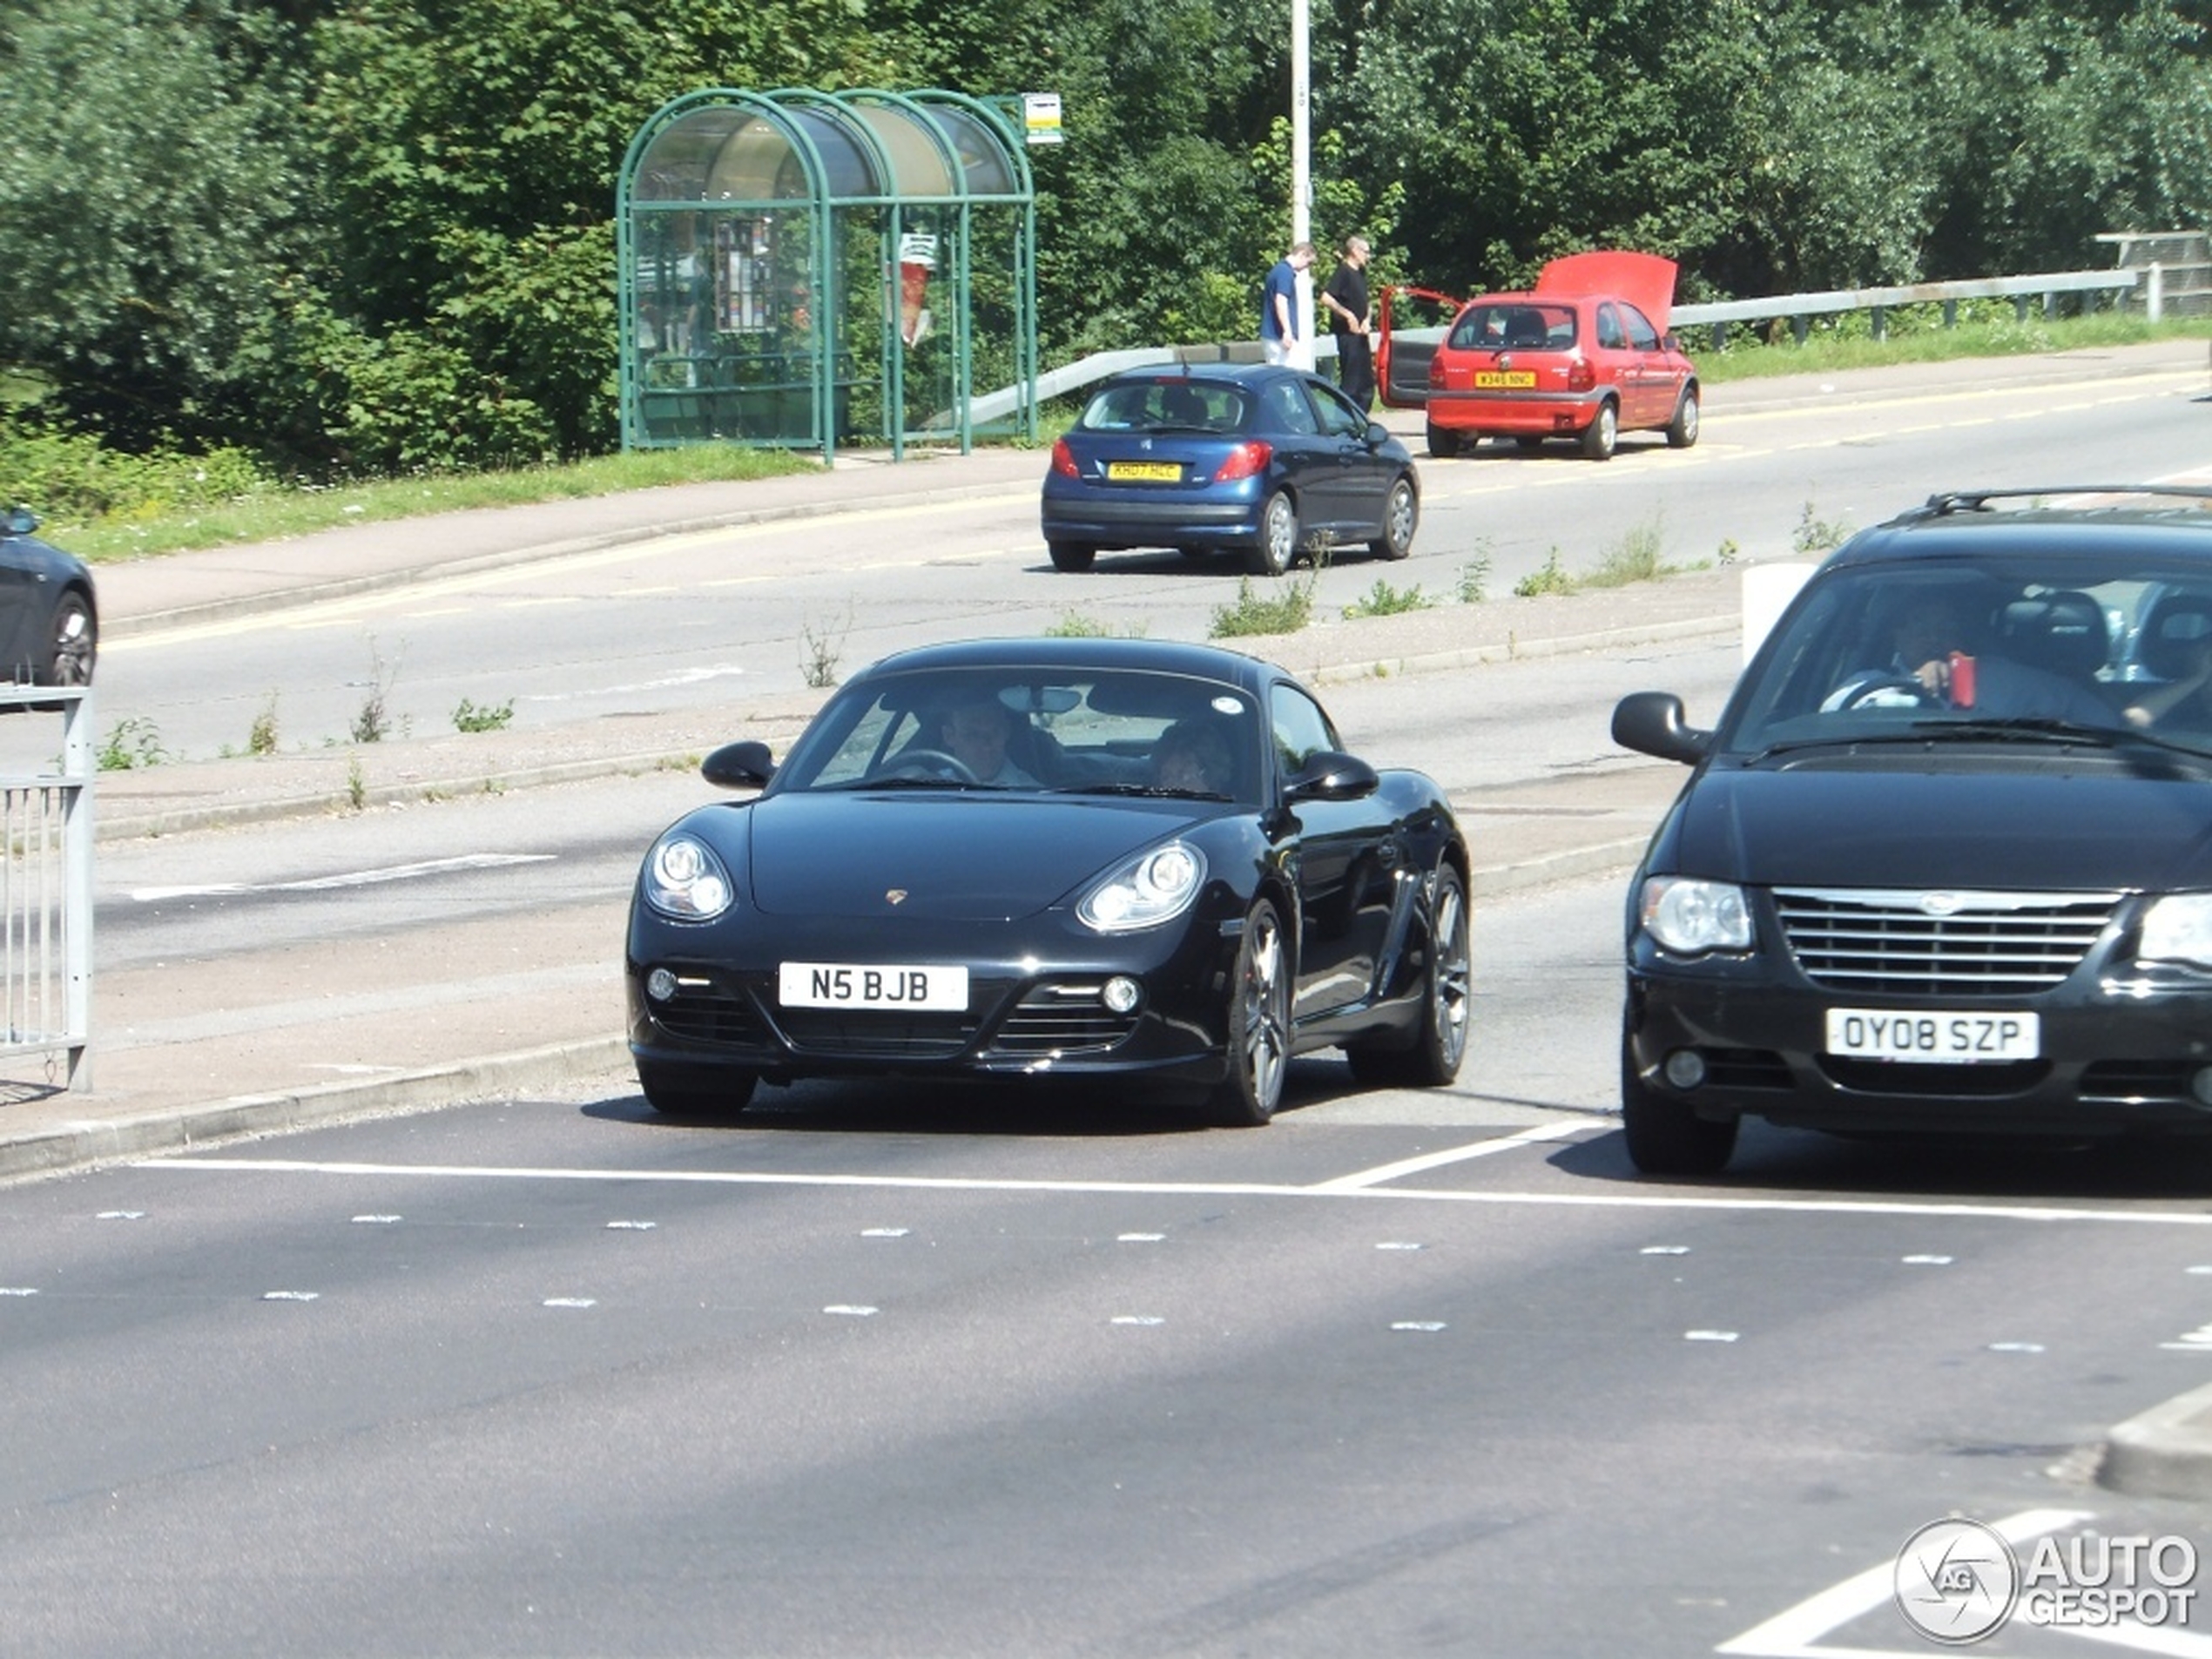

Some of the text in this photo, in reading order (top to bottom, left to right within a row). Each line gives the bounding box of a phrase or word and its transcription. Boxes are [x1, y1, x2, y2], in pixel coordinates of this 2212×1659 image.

[813, 969, 927, 1001] N5 BJB
[1846, 1017, 2020, 1051] OY08 SZP
